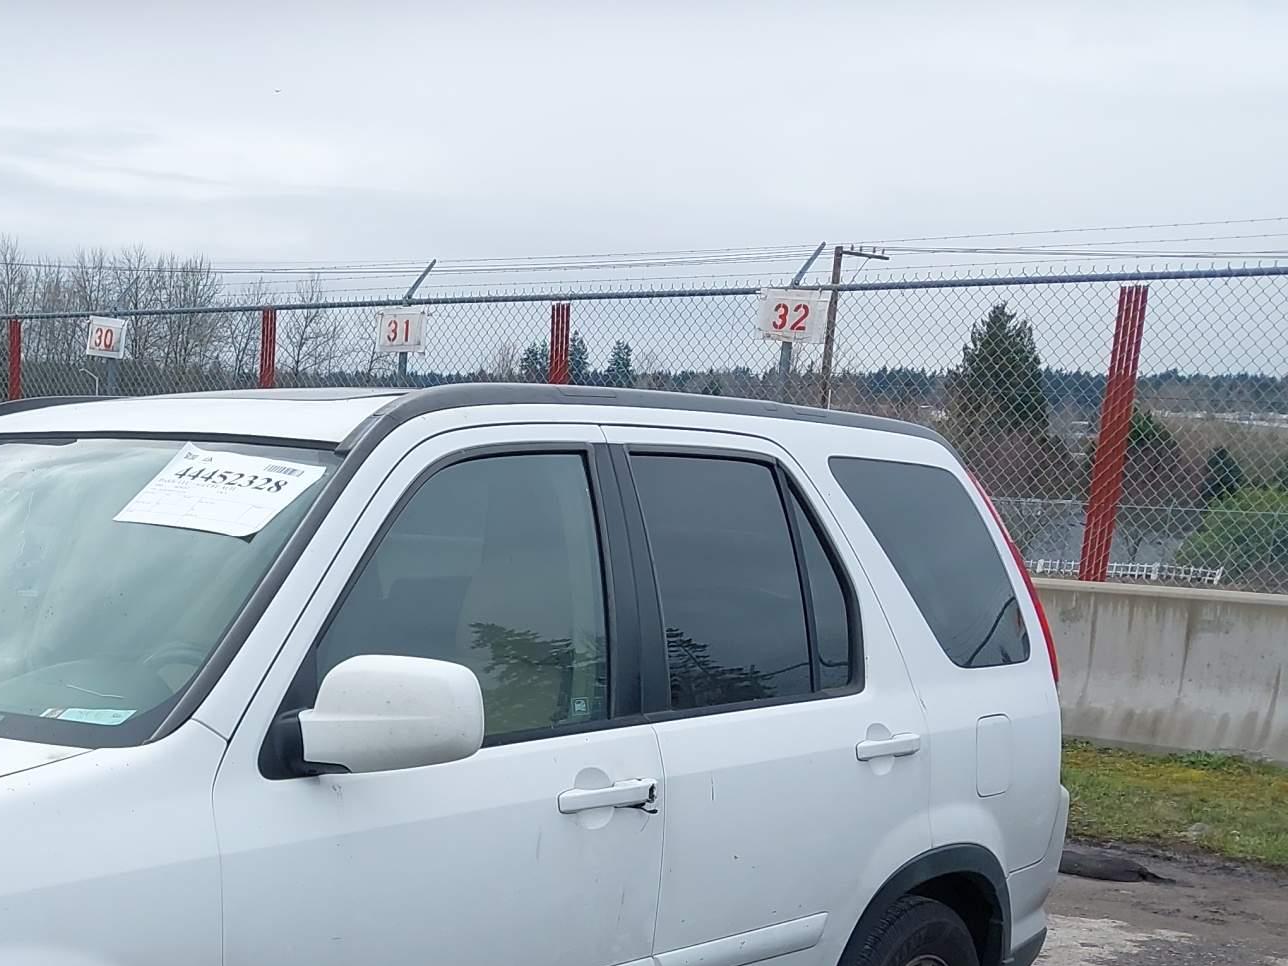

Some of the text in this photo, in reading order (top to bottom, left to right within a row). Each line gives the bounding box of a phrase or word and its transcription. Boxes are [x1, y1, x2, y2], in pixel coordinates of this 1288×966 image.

[772, 303, 810, 331] 32
[95, 328, 113, 349] 30
[387, 319, 410, 342] 31
[174, 466, 288, 493] 44452328
